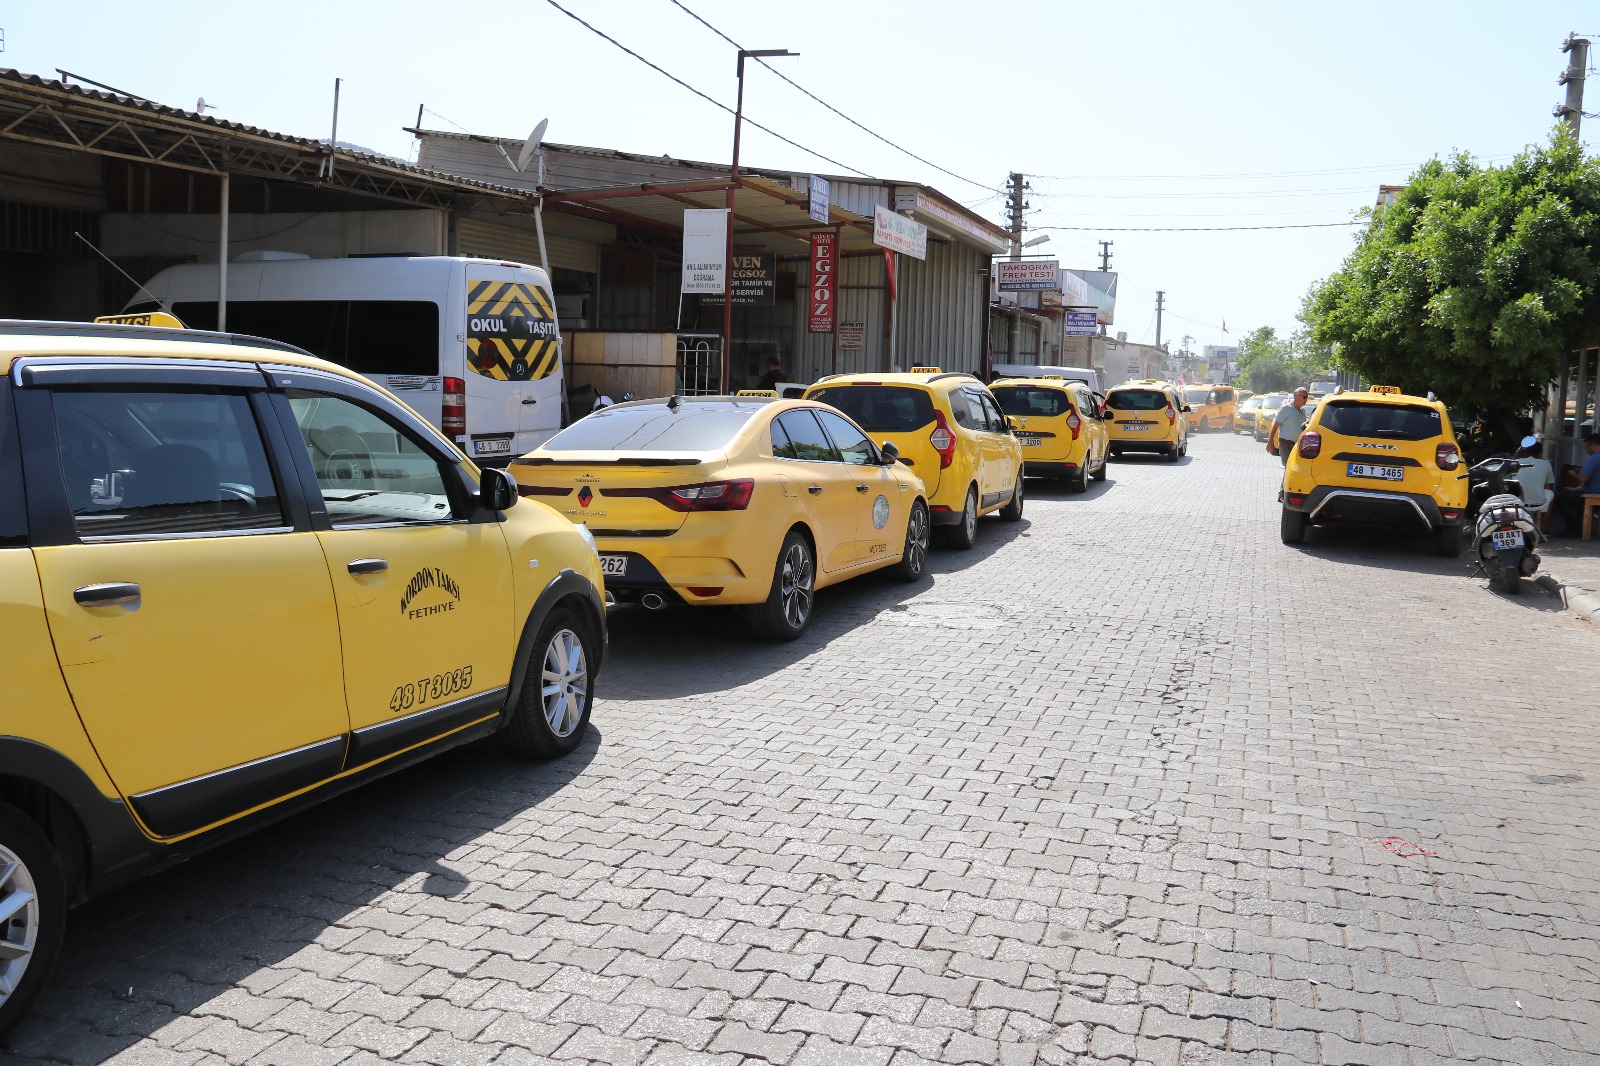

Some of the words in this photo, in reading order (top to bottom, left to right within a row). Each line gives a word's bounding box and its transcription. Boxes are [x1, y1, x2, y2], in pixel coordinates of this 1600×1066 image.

[813, 245, 832, 316] EGZOZ
[470, 318, 508, 332] OKUL
[526, 320, 557, 338] TAŞITI
[1355, 442, 1399, 450] DACIA
[1353, 465, 1364, 474] 48
[1369, 466, 1375, 475] T
[1380, 468, 1402, 477] 3465
[1493, 532, 1504, 540] 48
[1506, 530, 1521, 539] AKT
[1499, 539, 1516, 547] 369
[600, 557, 624, 573] 262
[408, 601, 455, 620] FETHIYE
[389, 683, 415, 712] 48
[417, 677, 431, 704] T
[430, 665, 473, 700] 3035
